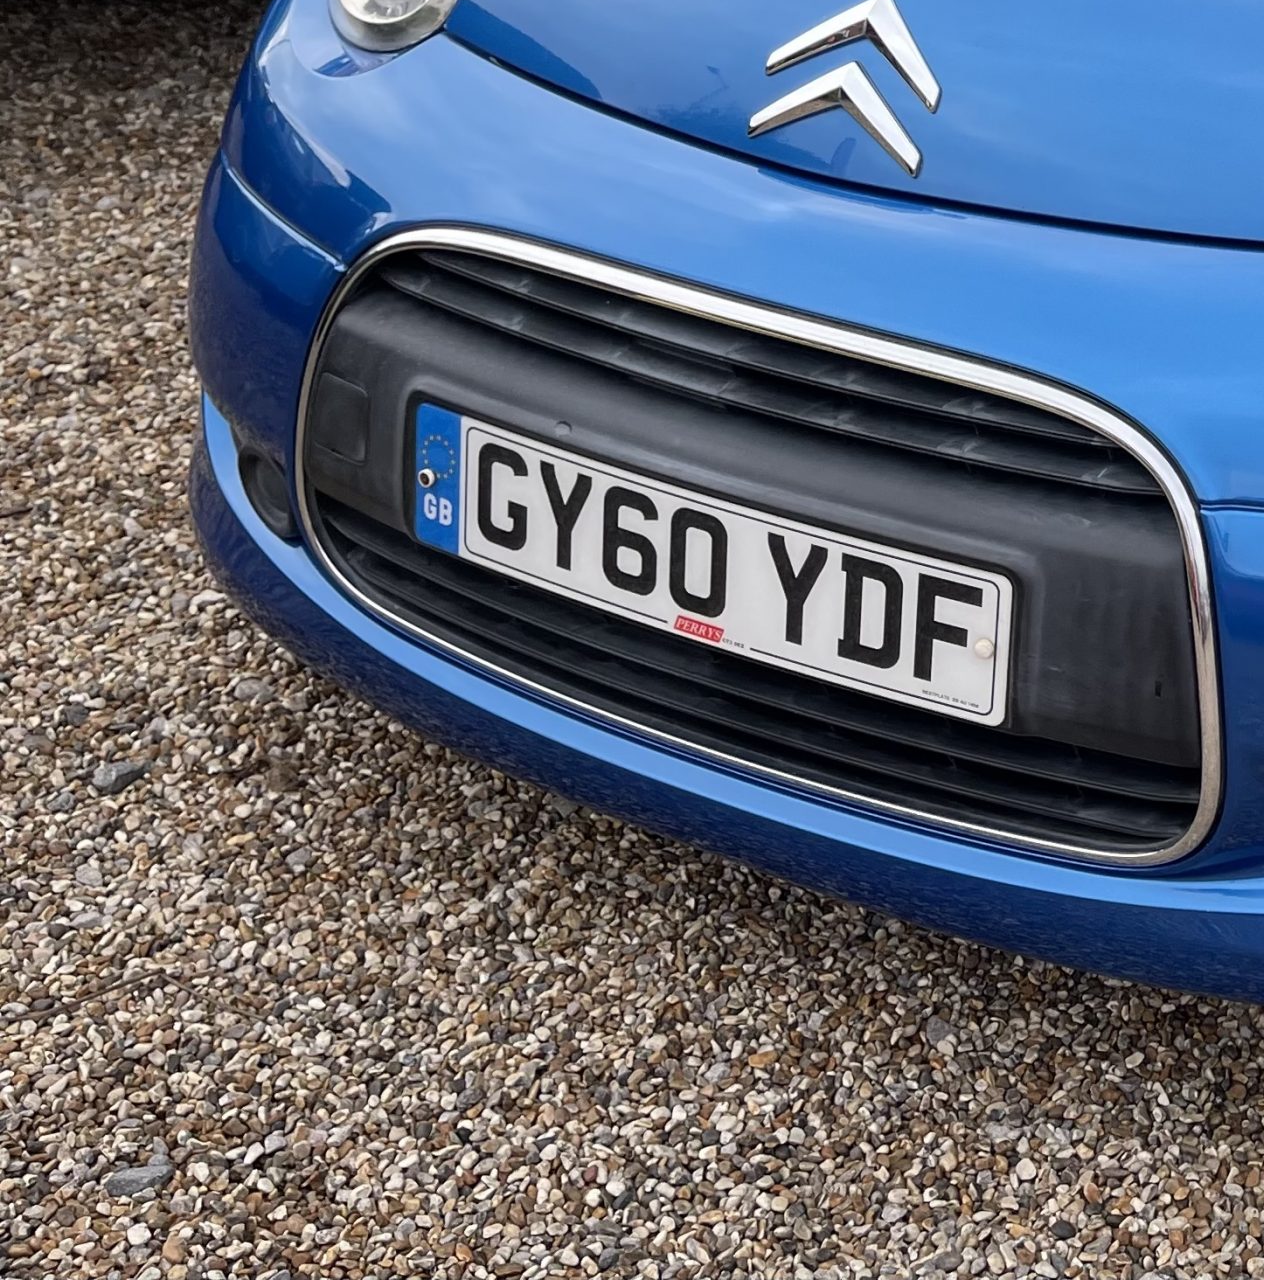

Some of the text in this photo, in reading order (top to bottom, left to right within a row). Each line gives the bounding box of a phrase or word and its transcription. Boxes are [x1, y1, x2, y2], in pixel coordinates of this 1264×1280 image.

[423, 492, 452, 526] GB
[477, 442, 983, 682] GY60 YDF
[676, 618, 722, 641] PERRYS
